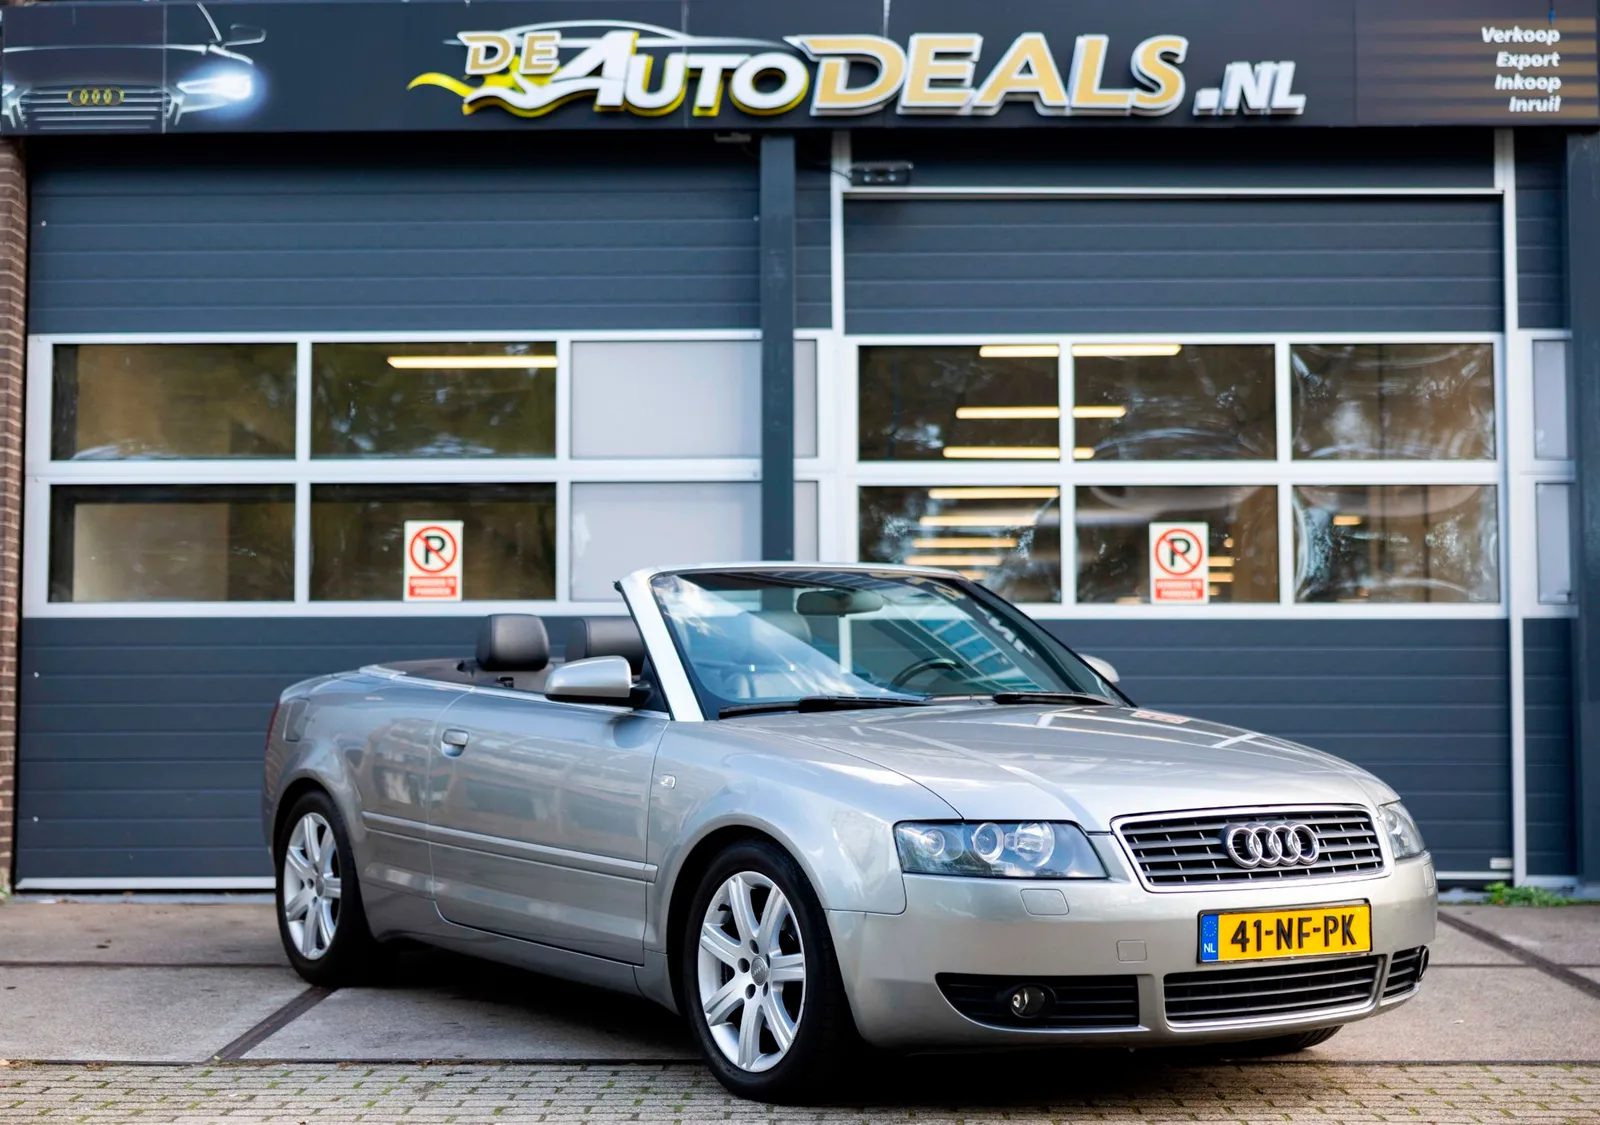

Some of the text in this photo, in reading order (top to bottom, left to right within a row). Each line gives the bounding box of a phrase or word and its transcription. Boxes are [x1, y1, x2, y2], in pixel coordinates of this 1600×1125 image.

[1481, 25, 1561, 46] Verkoop
[1495, 51, 1561, 71] Export
[1494, 73, 1562, 93] Inkoop
[1508, 95, 1562, 112] Inruil
[1203, 914, 1356, 953] NL 41-NF-PK
